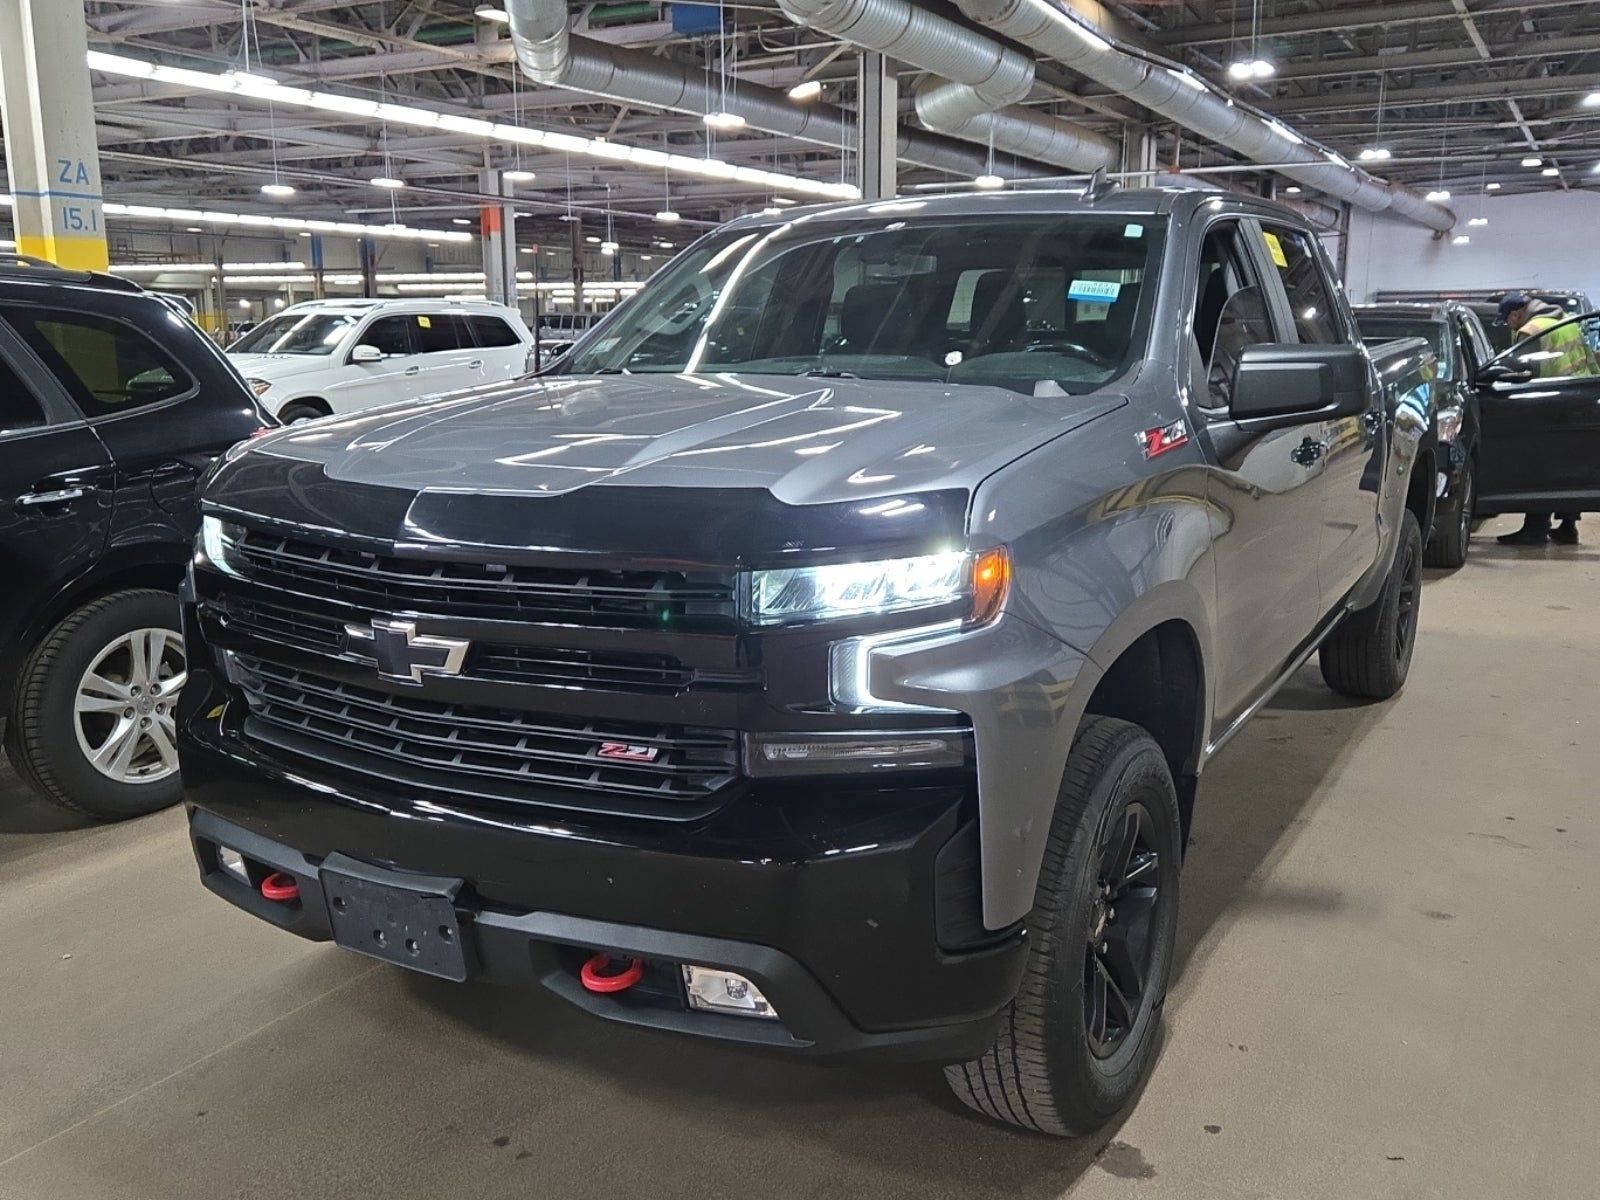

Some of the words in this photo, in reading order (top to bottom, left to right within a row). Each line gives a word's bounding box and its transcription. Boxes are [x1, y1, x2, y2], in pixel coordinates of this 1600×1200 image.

[57, 159, 90, 185] ZA
[62, 206, 97, 231] 15.1
[597, 742, 659, 761] Z71
